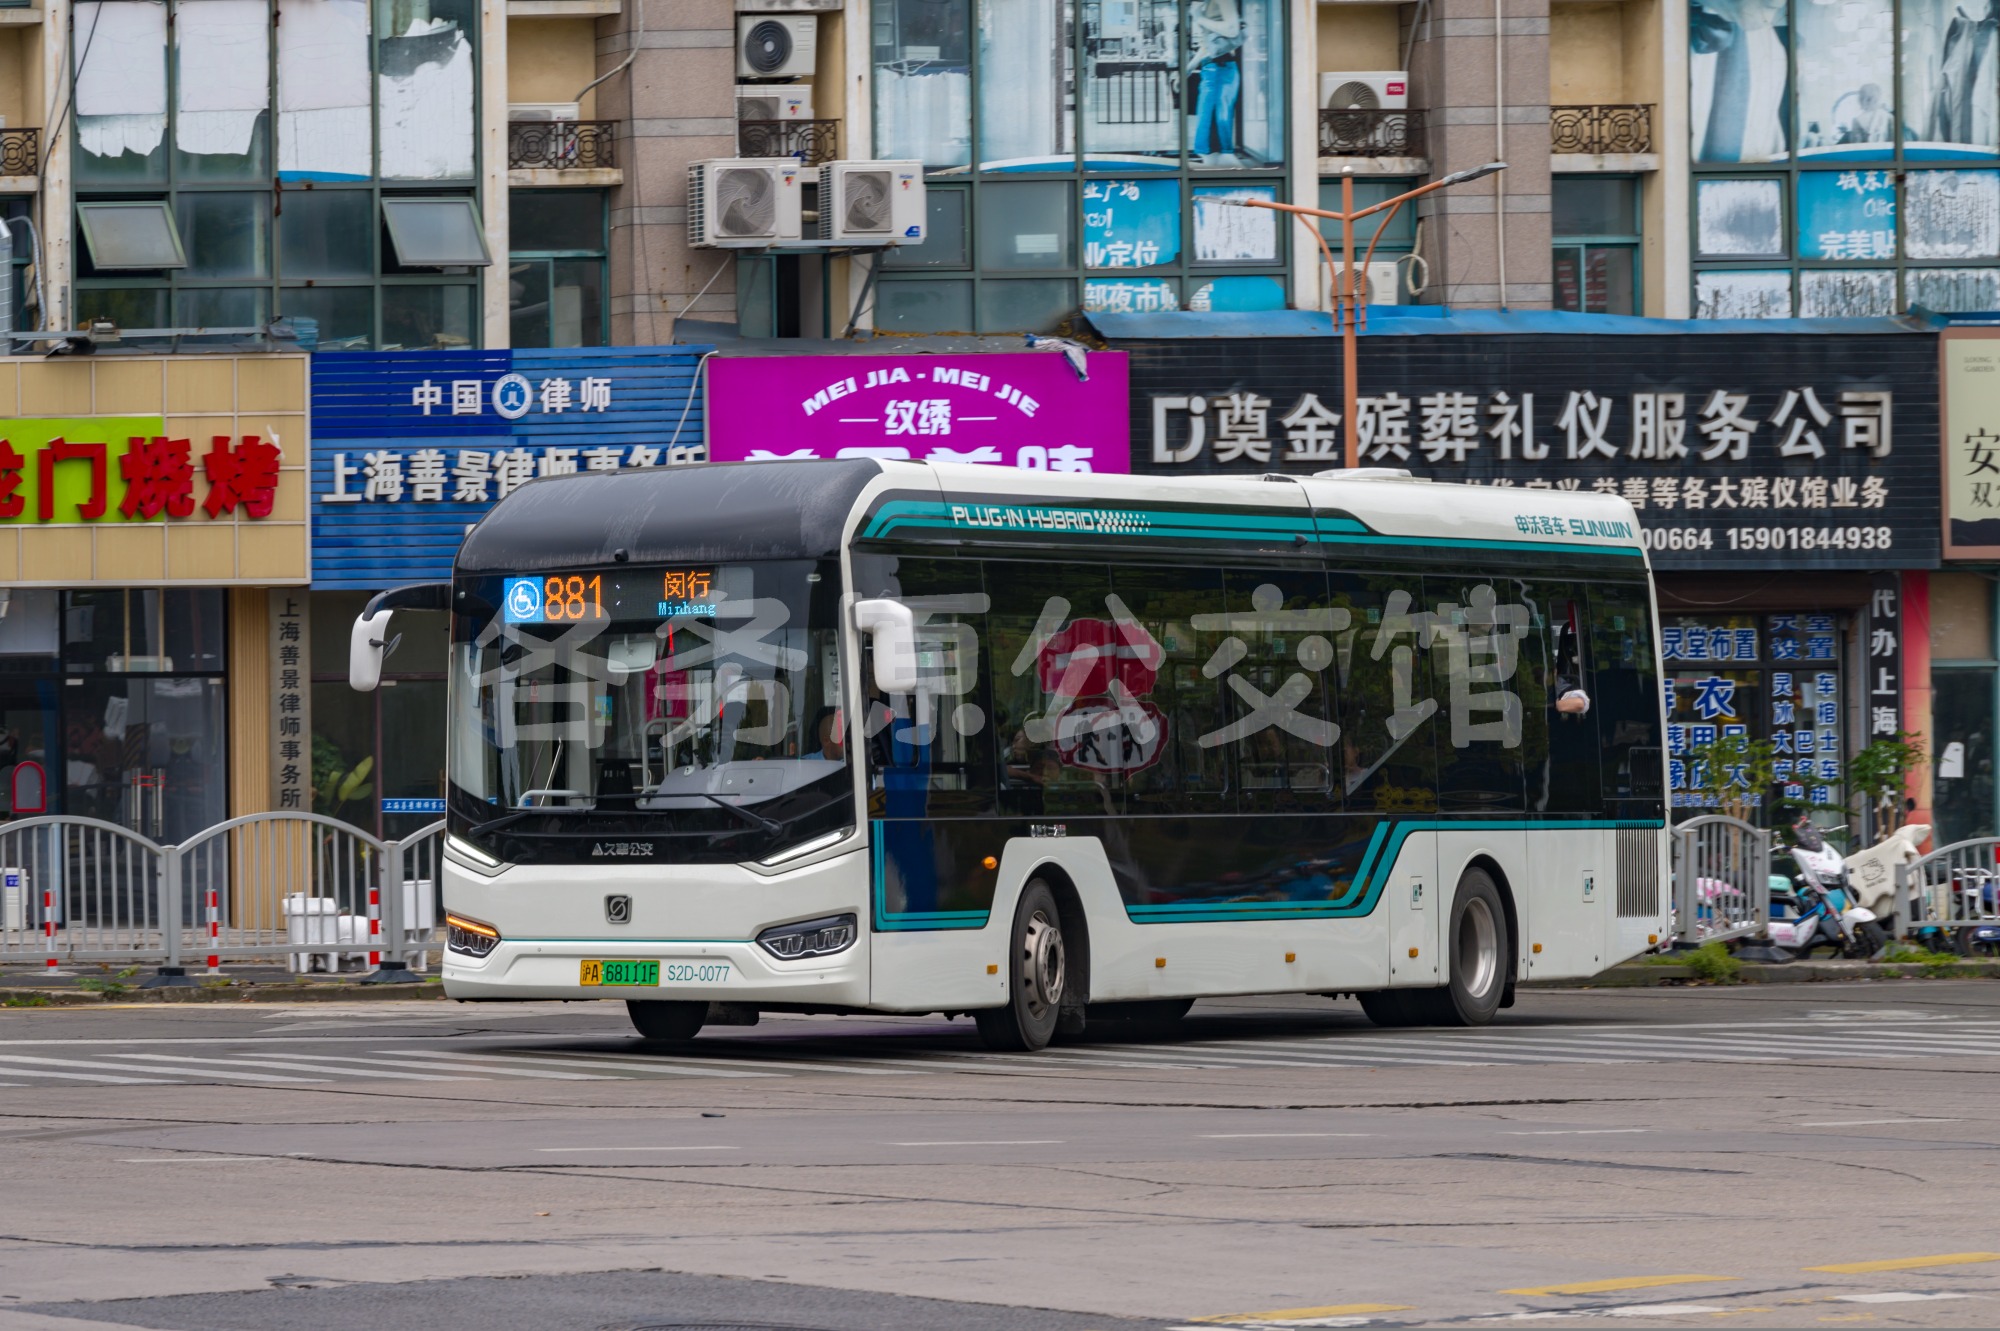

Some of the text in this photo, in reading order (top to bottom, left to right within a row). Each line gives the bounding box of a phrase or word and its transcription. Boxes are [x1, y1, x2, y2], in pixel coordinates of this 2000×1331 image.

[412, 377, 612, 415] 中国 律师
[802, 377, 857, 416] MEI
[864, 367, 911, 389] JIA
[932, 366, 991, 392] MEI
[994, 384, 1040, 418] JIE
[884, 399, 951, 436] 纹绣
[1213, 388, 1893, 463] 奠金殡葬礼仪服务公司
[1969, 482, 2000, 508] 双
[1027, 509, 1095, 530] HYBRID
[1515, 514, 1633, 539] 申沃客车 SUNWIN
[1727, 526, 1893, 550] 15901844938
[545, 575, 601, 620] 881
[664, 571, 710, 600] 闵行
[658, 601, 717, 617] Minhang
[1662, 627, 1758, 661] 灵堂布置
[279, 597, 301, 808] 上海善景律师事务所
[667, 964, 730, 982] S2D-0077
